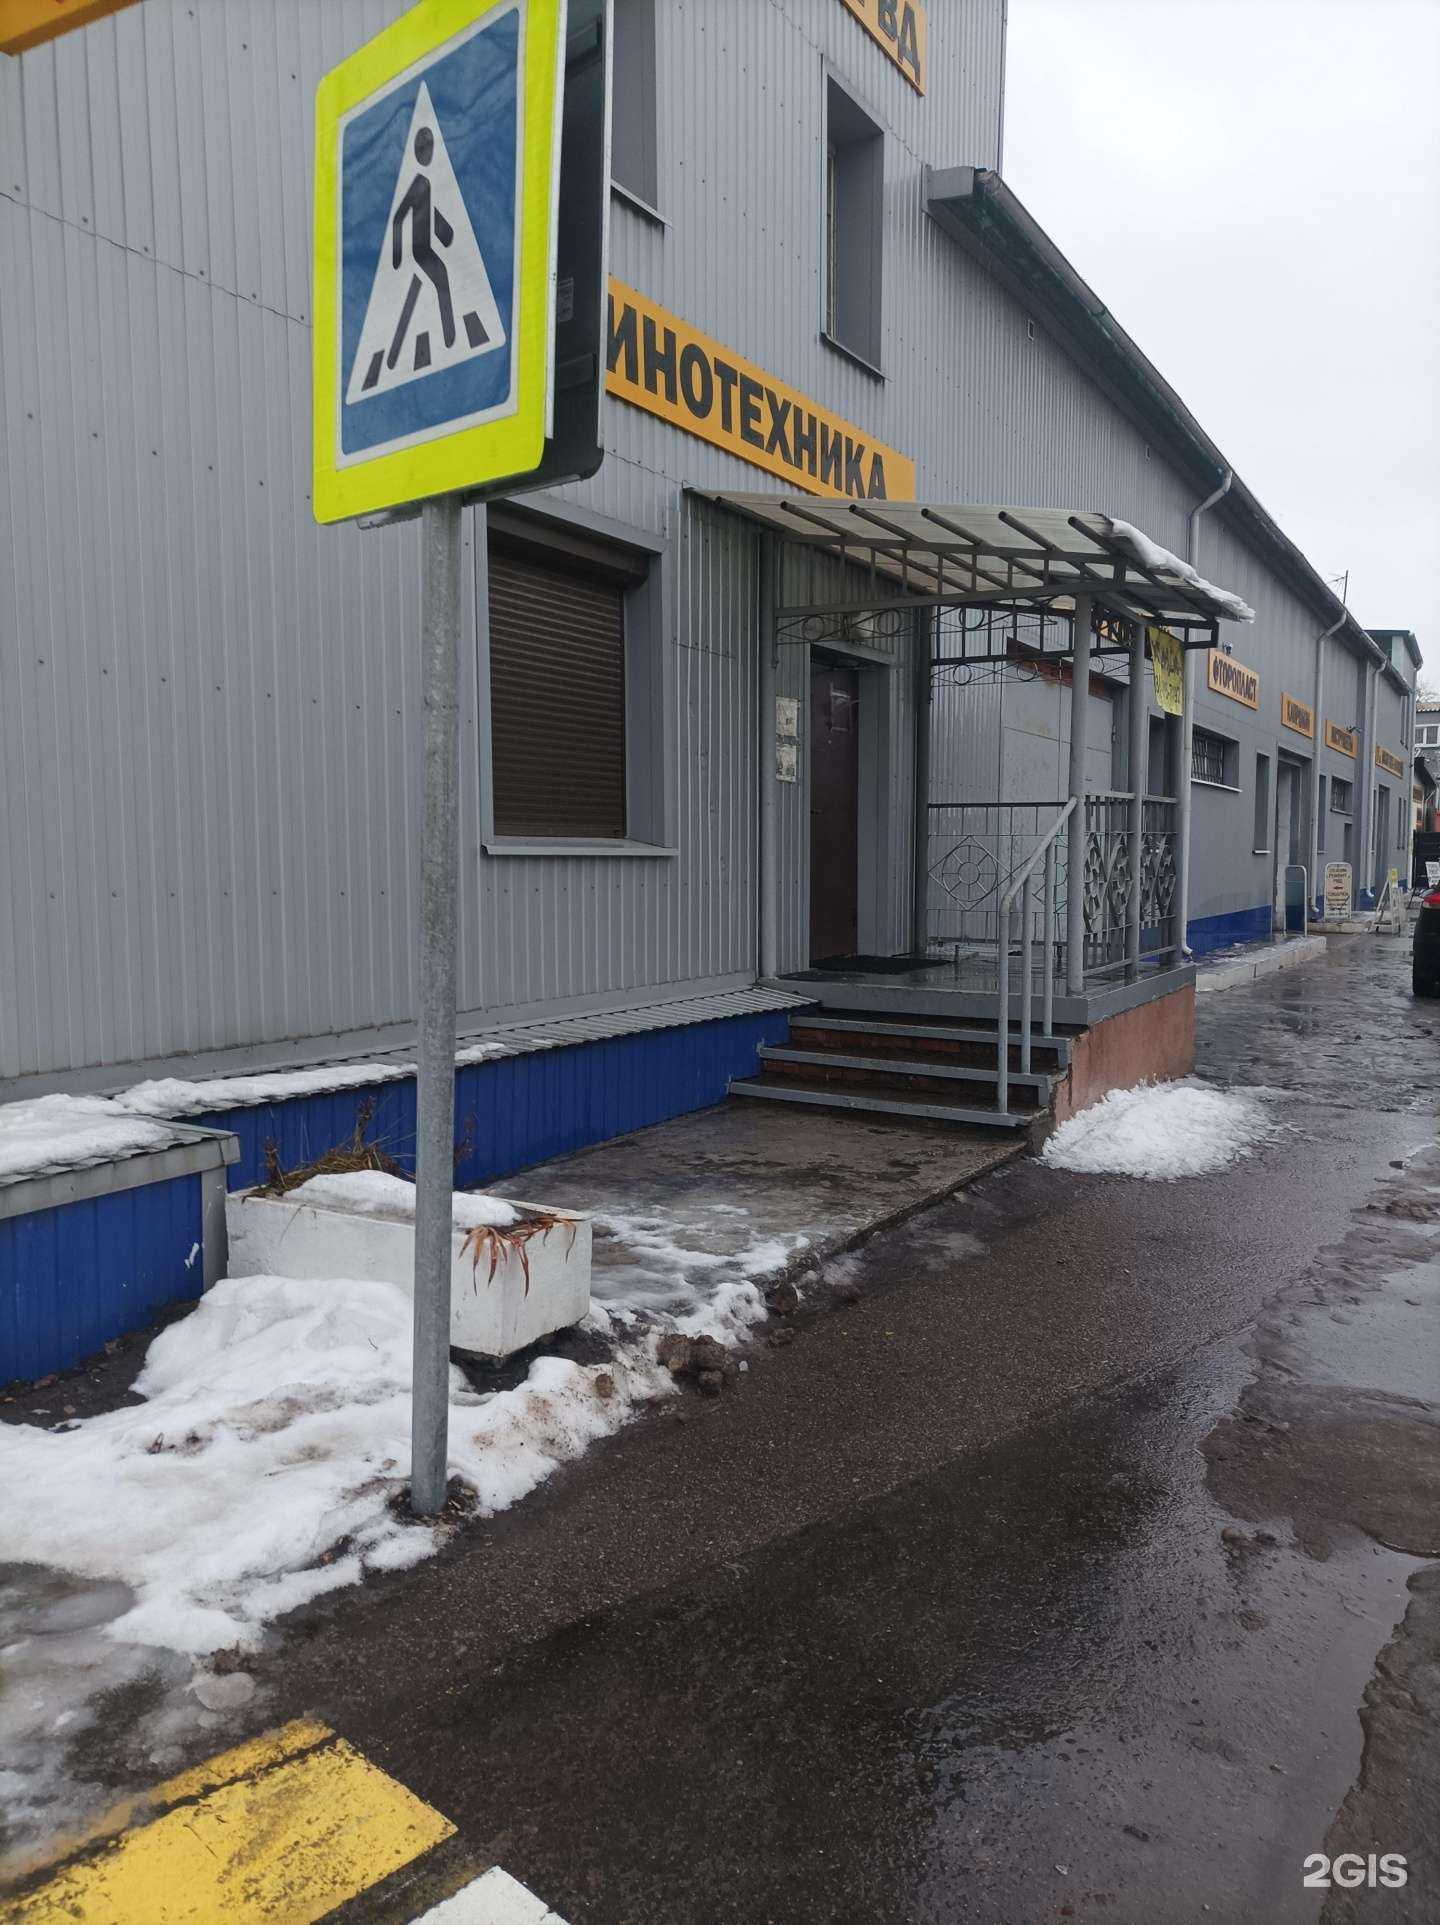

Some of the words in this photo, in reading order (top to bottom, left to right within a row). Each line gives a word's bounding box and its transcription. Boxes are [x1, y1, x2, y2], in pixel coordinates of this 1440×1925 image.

[857, 0, 921, 86] ВА
[607, 293, 887, 500] ИНОТЕХНИКА
[1213, 655, 1257, 702] ФТОРОПЛАСТ
